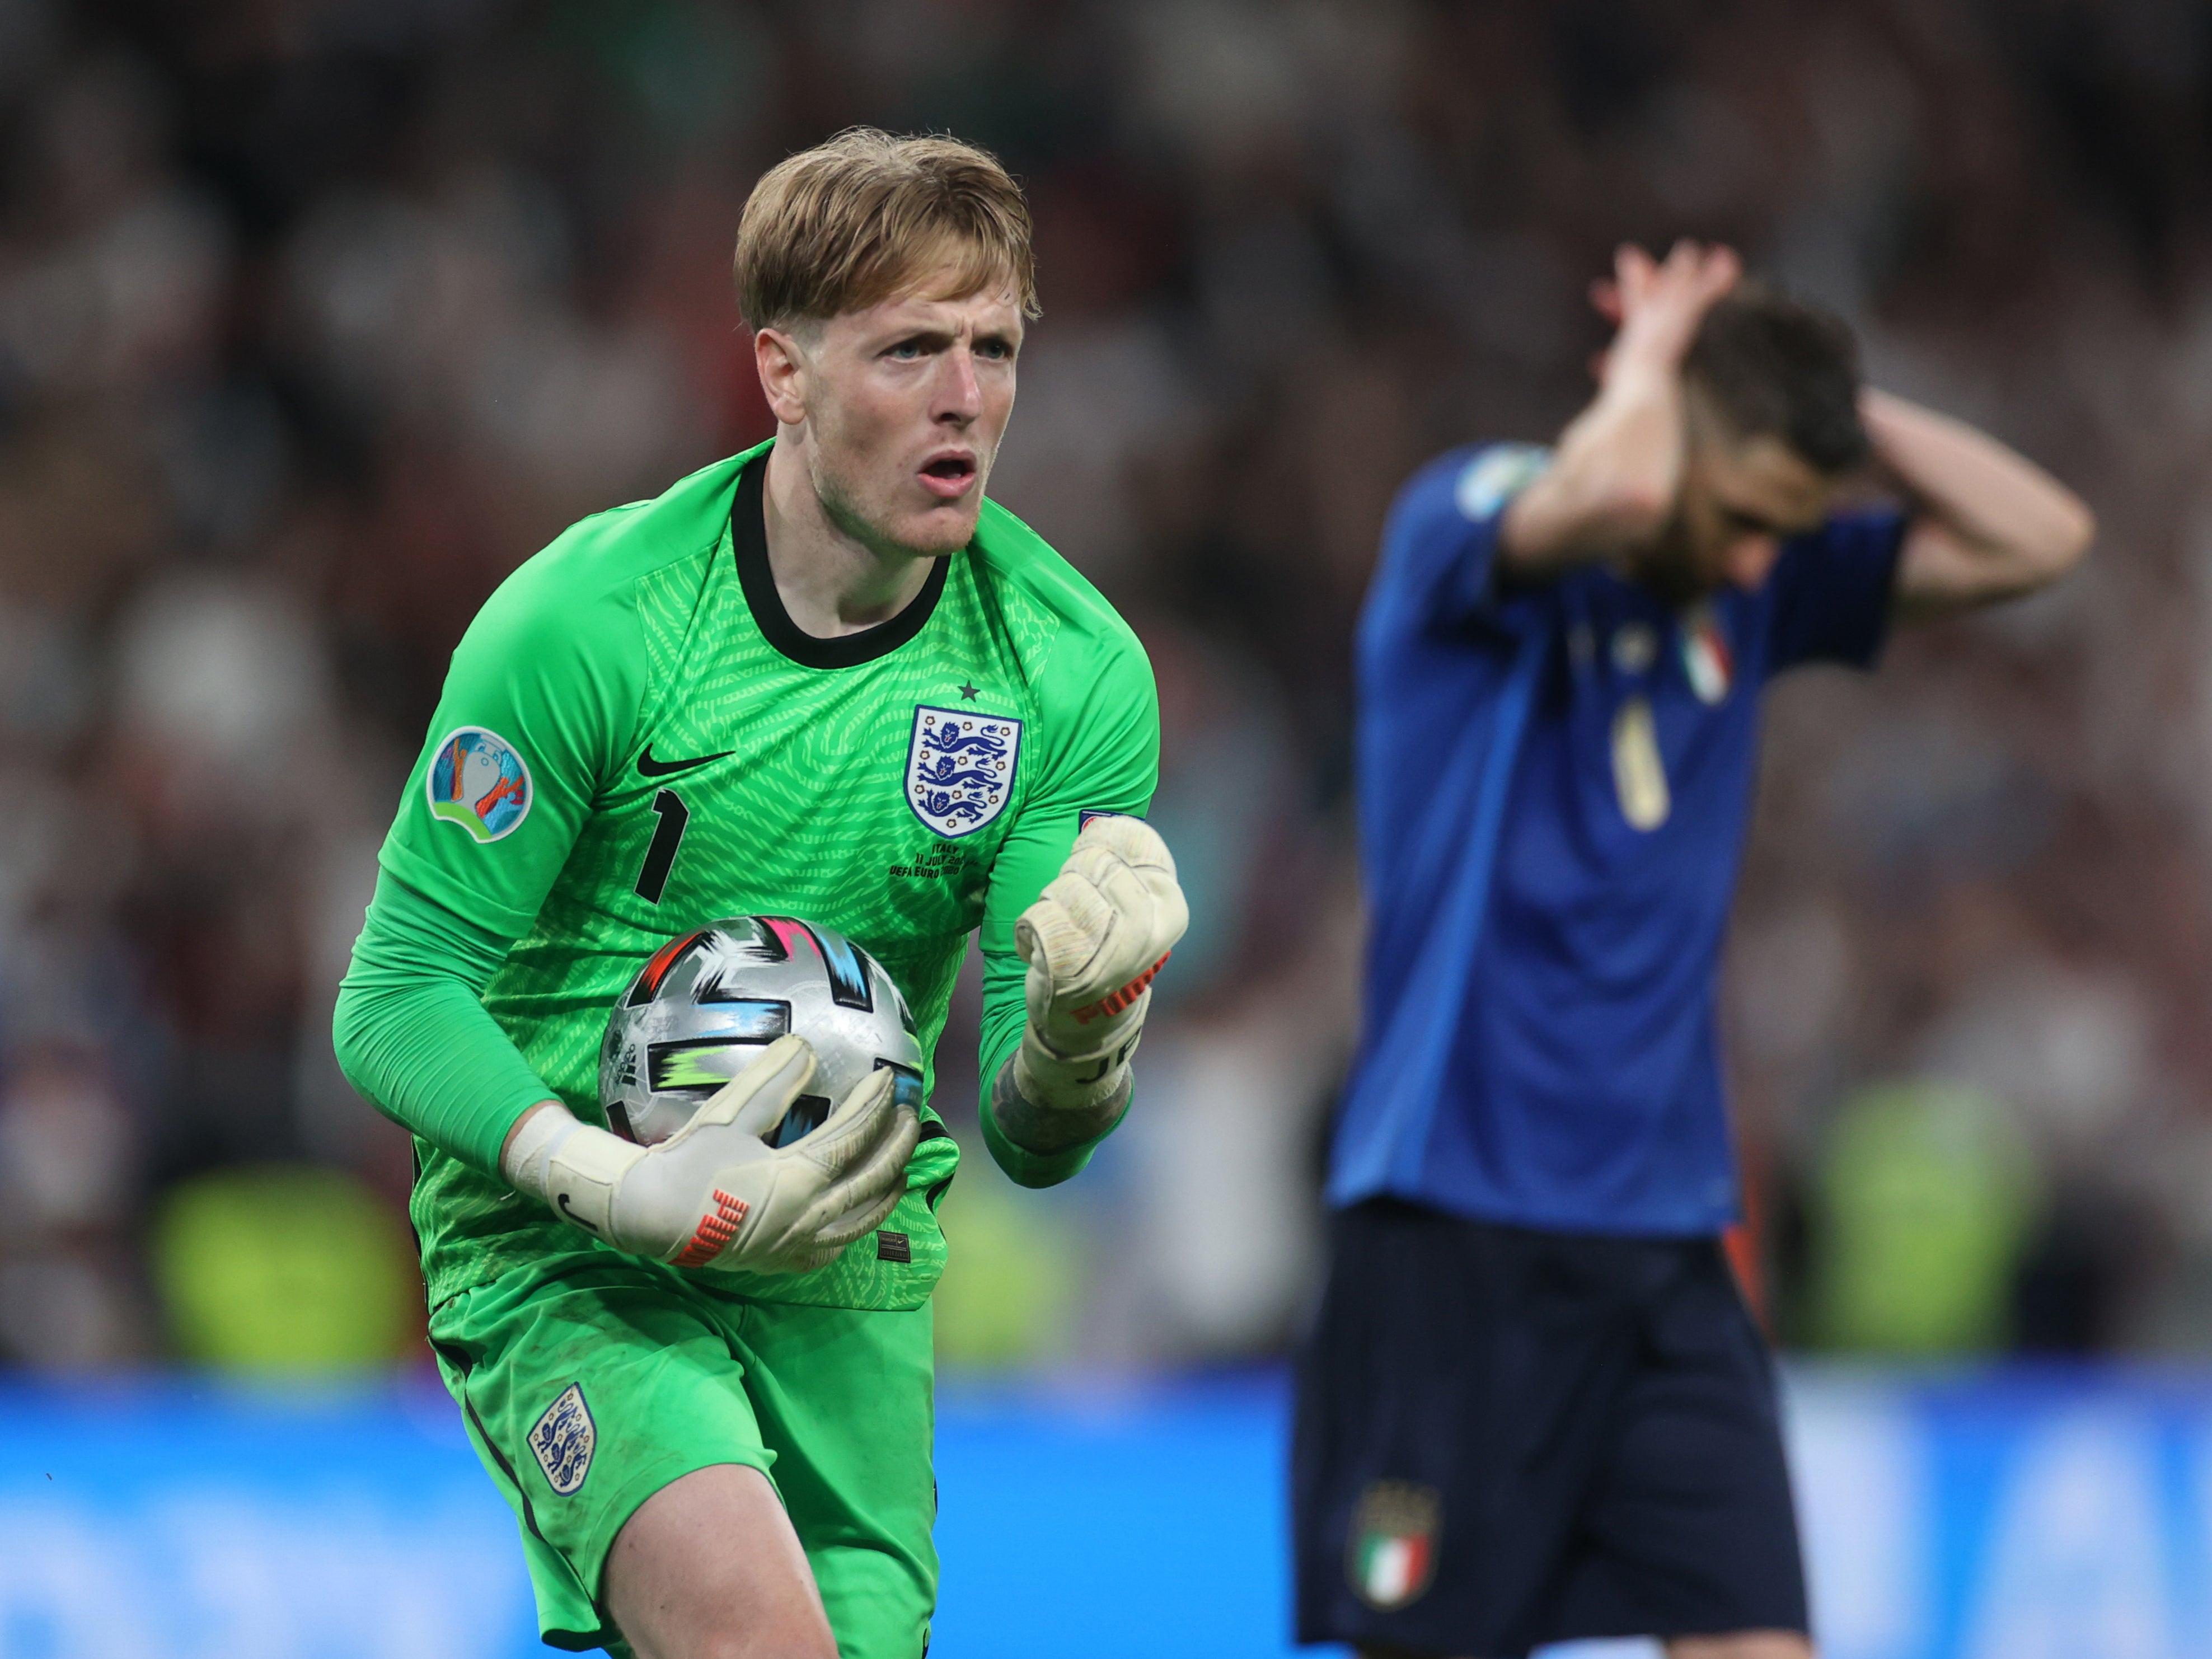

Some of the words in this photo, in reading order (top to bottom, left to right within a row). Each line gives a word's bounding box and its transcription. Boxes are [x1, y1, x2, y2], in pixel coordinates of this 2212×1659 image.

[634, 787, 690, 906] 1
[931, 843, 959, 855] ITALY
[915, 853, 924, 864] 11
[925, 855, 948, 866] JULY
[889, 865, 912, 878] UEFA
[915, 866, 940, 879] EURO
